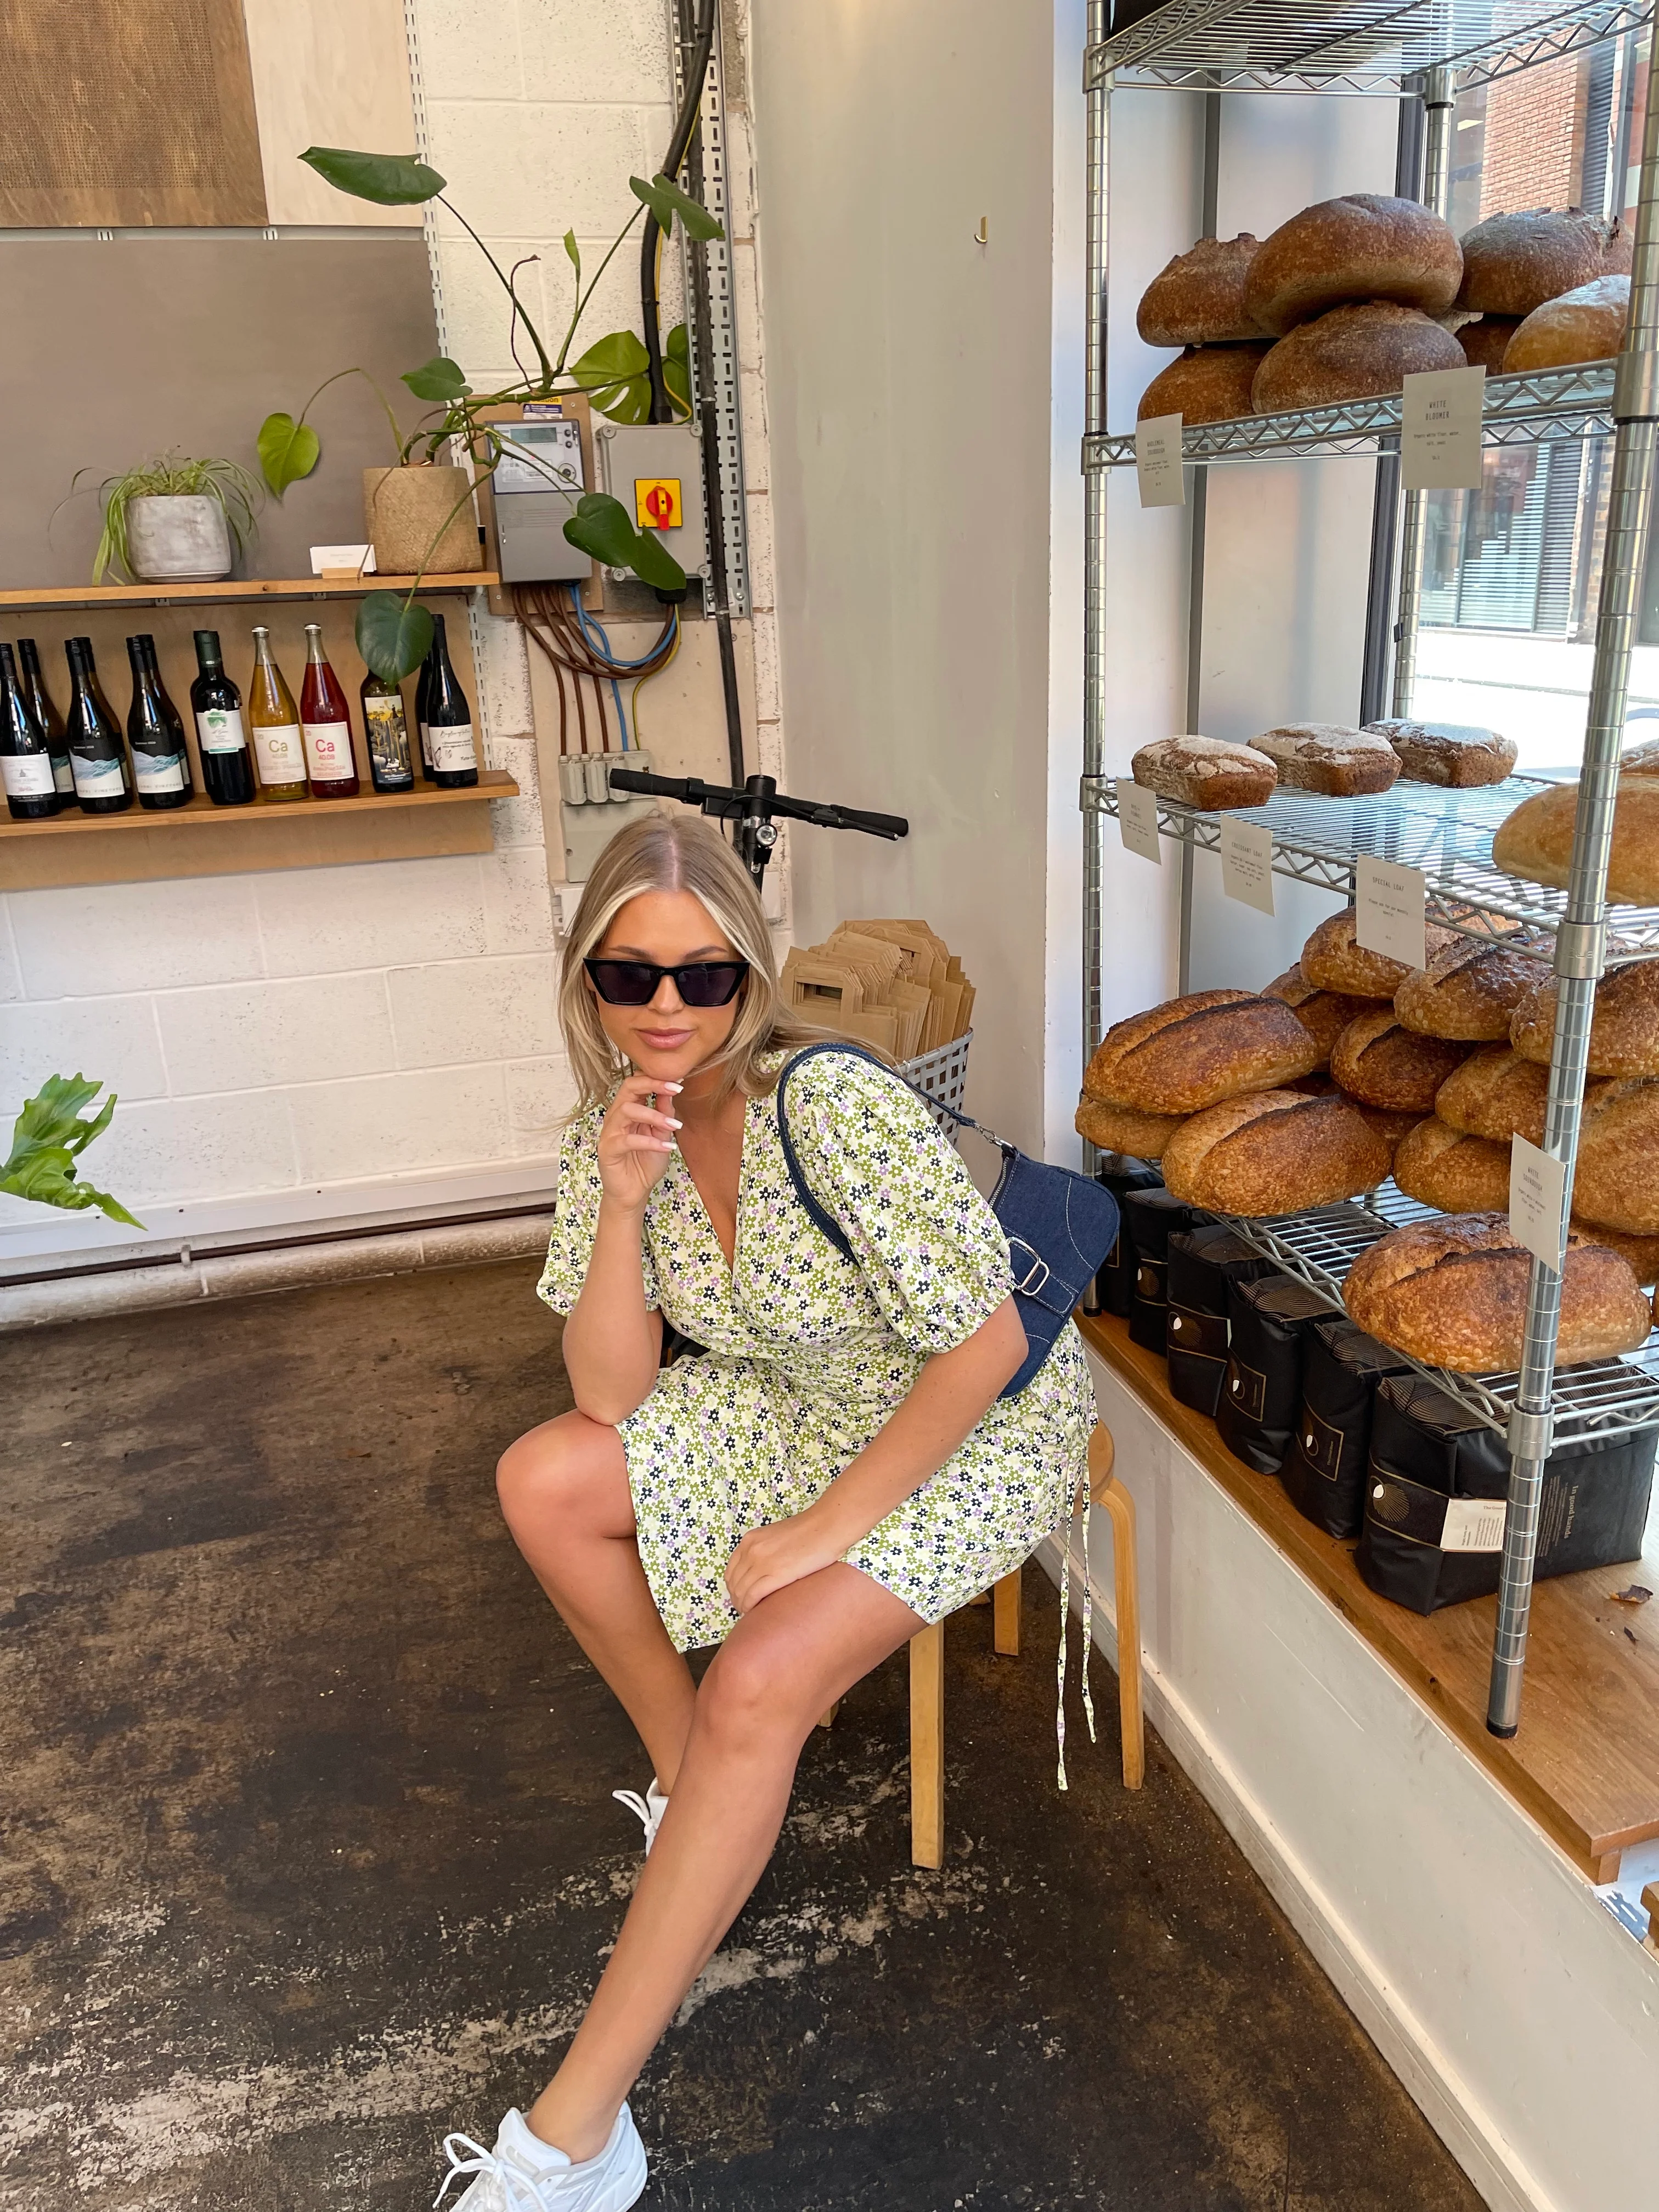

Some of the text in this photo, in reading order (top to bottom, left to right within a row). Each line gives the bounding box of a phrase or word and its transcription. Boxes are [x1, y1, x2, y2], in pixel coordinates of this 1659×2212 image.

[1426, 411, 1449, 420] BLOOMER
[269, 740, 288, 753] Ca
[315, 739, 335, 753] Ca
[1232, 842, 1263, 858] CROISSANT LOAF
[1373, 877, 1404, 891] SPECIAL LOAF
[1572, 1485, 1579, 1494] In
[1564, 1515, 1575, 1539] hands
